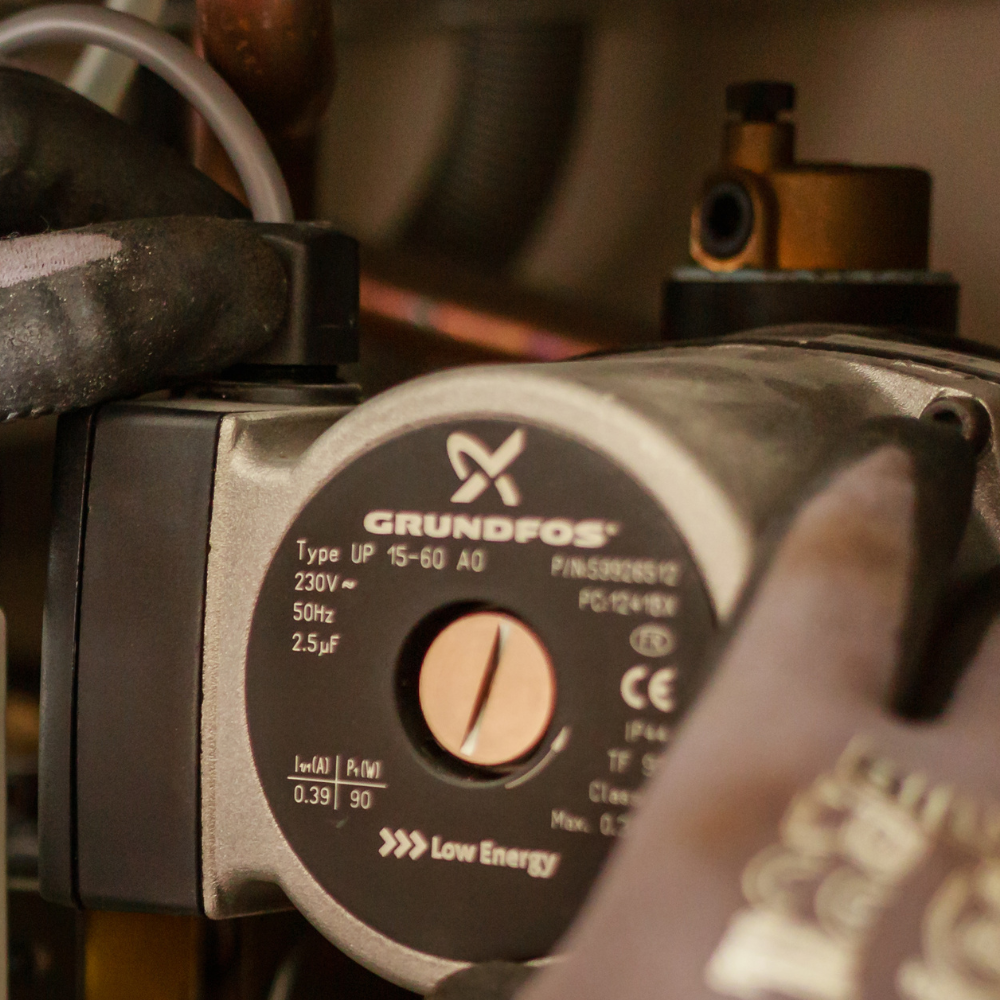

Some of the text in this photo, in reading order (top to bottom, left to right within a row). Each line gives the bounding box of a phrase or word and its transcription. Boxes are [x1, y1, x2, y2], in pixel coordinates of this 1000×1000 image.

[363, 509, 608, 549] GRUNDFOS
[297, 539, 339, 566] Type
[351, 543, 375, 564] UP
[387, 545, 446, 570] 15-60
[293, 602, 335, 624] 50Hz
[293, 784, 371, 810] 0.39 90
[430, 835, 561, 879] Low Energy
